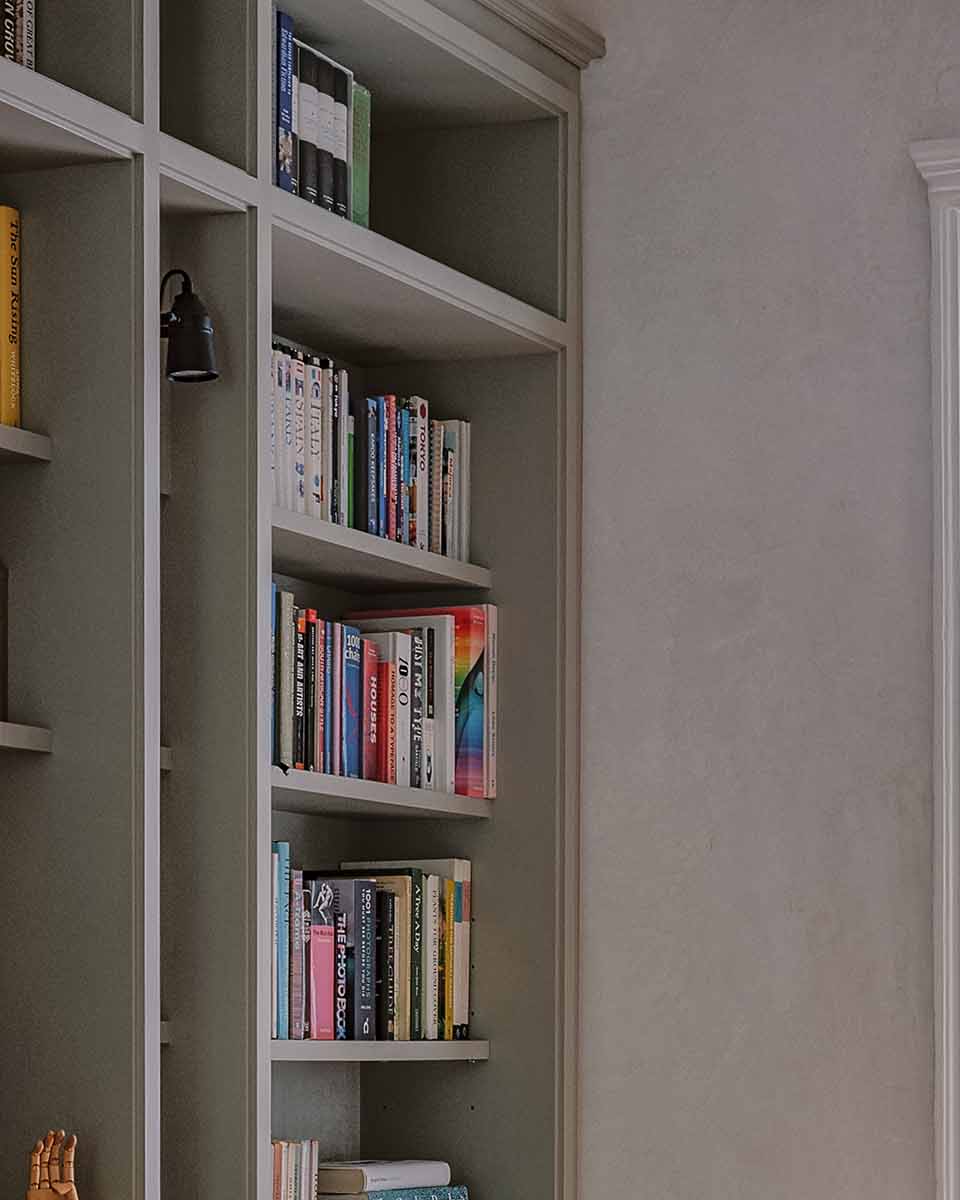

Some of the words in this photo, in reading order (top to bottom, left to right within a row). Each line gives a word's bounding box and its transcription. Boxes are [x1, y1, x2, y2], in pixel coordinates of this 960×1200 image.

[26, 0, 33, 16] OF
[10, 219, 18, 250] The
[9, 291, 18, 345] Rising
[296, 399, 304, 455] SPAIN
[310, 400, 321, 457] ITALY
[296, 642, 304, 661] ART
[414, 636, 422, 668] JUST
[296, 661, 304, 681] AND
[296, 681, 304, 719] ARTISTS
[414, 672, 422, 703] MY
[390, 712, 396, 727] TO
[390, 728, 396, 736] A
[412, 707, 422, 742] TYPE
[415, 885, 421, 895] A
[336, 913, 346, 943] THE
[415, 920, 421, 931] A
[413, 932, 421, 953] Day
[336, 944, 346, 996] PHOTO
[336, 997, 346, 1040] BOOK
